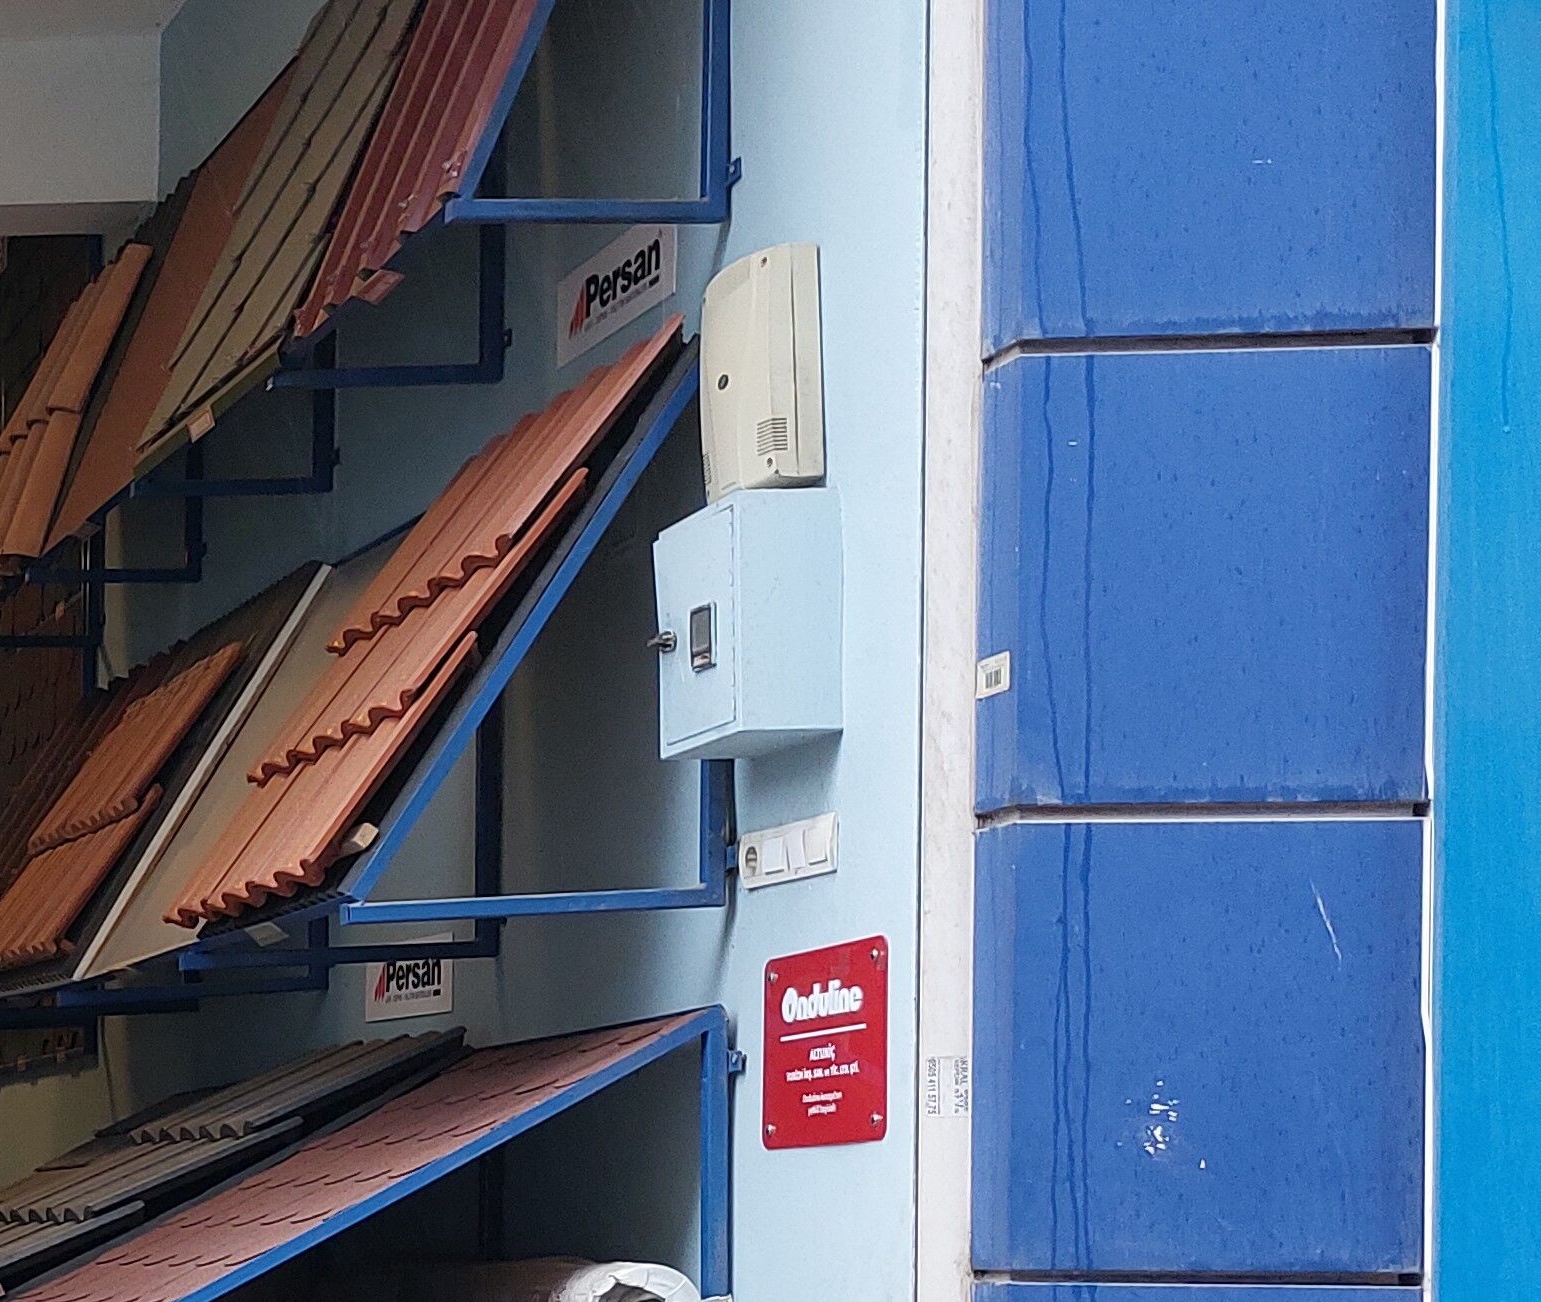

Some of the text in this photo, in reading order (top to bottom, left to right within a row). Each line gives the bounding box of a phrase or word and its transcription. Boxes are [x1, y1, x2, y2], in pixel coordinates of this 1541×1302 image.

[585, 239, 660, 318] Persan
[386, 959, 441, 992] Persan
[781, 979, 864, 1023] Onduline
